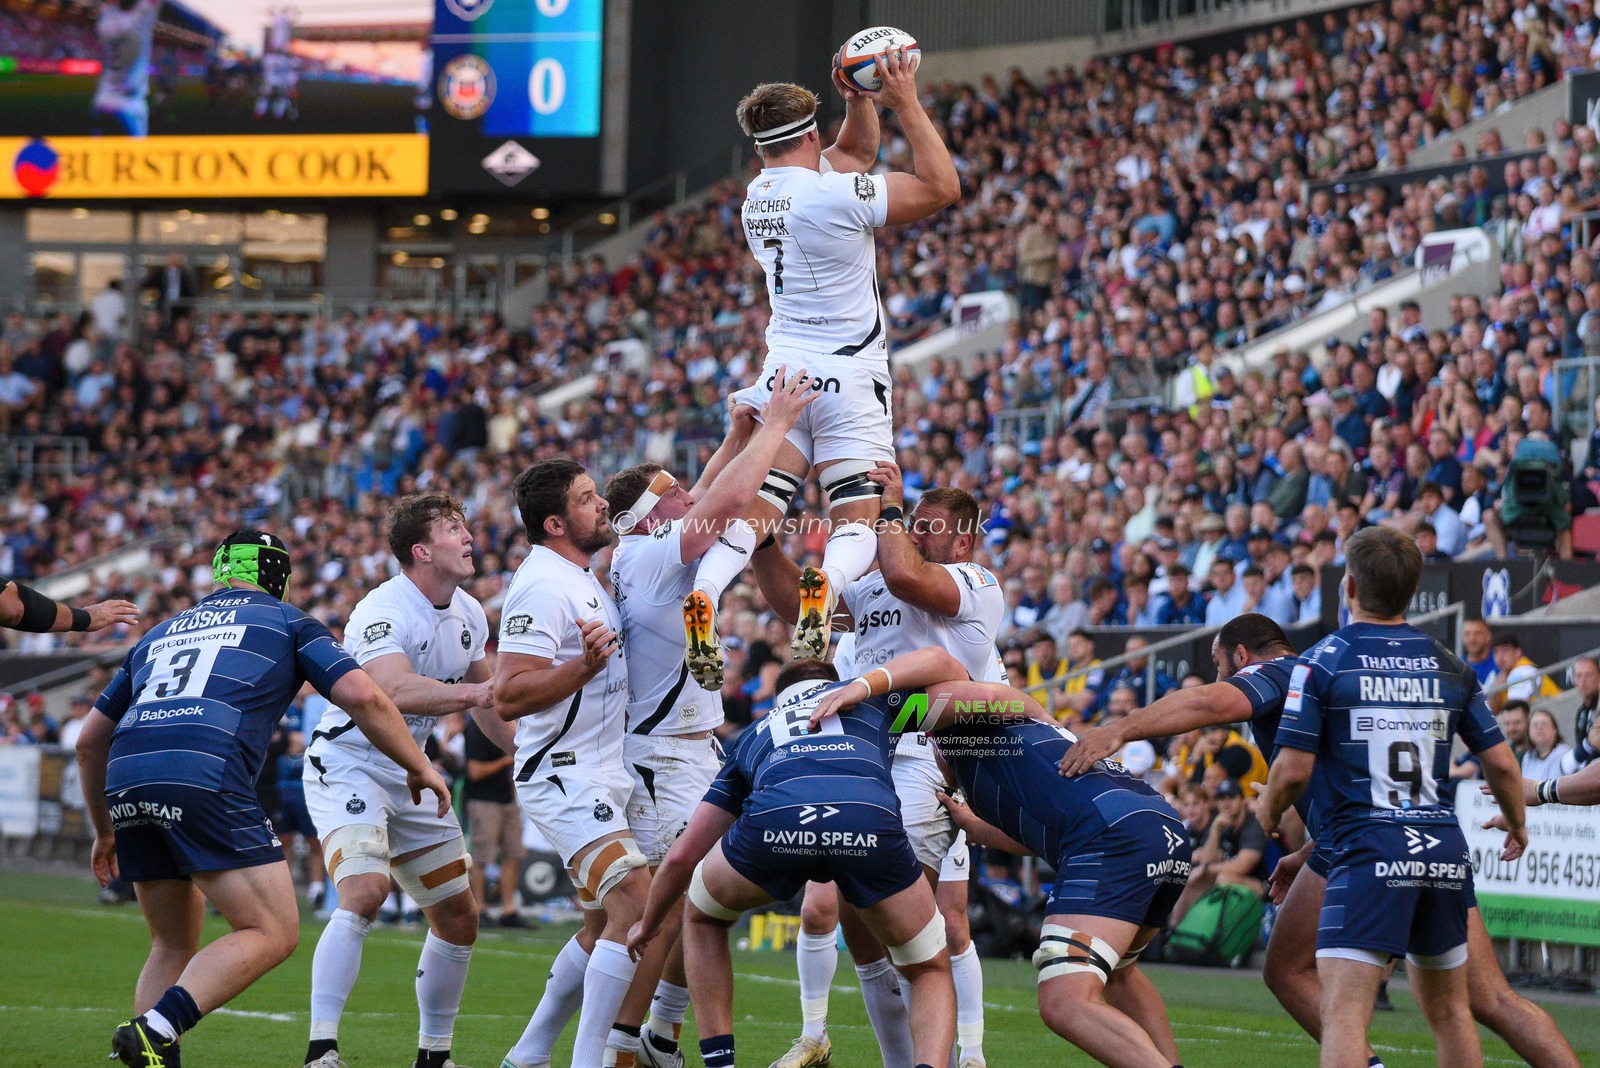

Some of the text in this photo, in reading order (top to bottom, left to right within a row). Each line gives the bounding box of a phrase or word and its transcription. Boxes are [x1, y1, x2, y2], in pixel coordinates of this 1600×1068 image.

[528, 57, 566, 115] 0
[60, 147, 392, 183] BURSTON COOK
[744, 196, 792, 213] THATCHERS
[763, 238, 784, 294] 7
[165, 610, 238, 635] KLOSKA
[155, 647, 202, 698] 3
[1357, 655, 1440, 670] THATCHERS
[1359, 675, 1445, 703] RANDALL
[140, 706, 205, 721] Babcock
[790, 742, 856, 754] Babcock
[1388, 741, 1422, 807] 9
[109, 801, 183, 822] AVID SPEAR
[763, 830, 878, 848] DAVID SPEAR
[772, 846, 868, 857] COMMERCIAL VEHICLES
[1375, 860, 1427, 877] DAVID
[1527, 851, 1560, 885] 956
[1563, 853, 1600, 888] 4537
